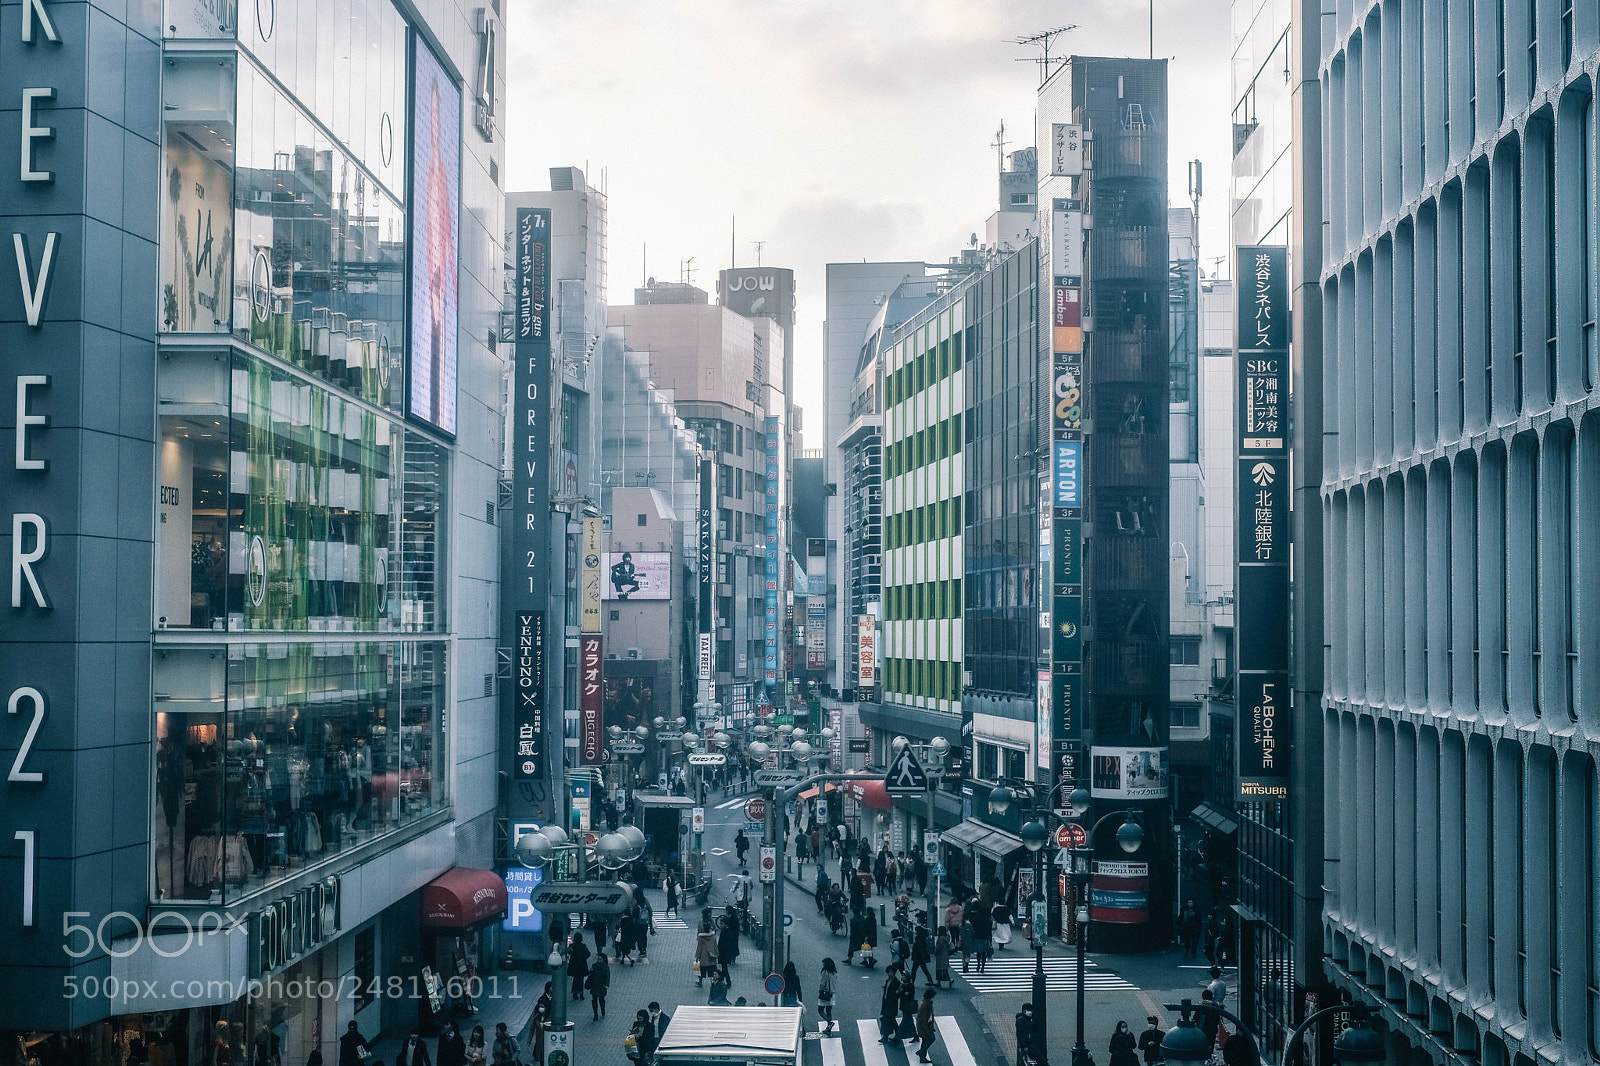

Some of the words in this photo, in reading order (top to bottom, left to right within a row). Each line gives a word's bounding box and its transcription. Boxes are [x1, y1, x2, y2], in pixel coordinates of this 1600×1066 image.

[1068, 129, 1078, 151] 渋谷
[1062, 201, 1073, 209] 7F
[534, 214, 546, 228] 7F
[196, 208, 214, 279] LA
[729, 275, 775, 292] JOW
[1062, 277, 1073, 286] 6F
[1056, 289, 1066, 325] amber
[1254, 253, 1271, 346] 渋谷シネパレス
[1246, 360, 1278, 372] SBC
[1254, 378, 1266, 433] クリニック
[1265, 378, 1278, 433] 湘南美容
[526, 357, 537, 530] FOREVER
[1062, 431, 1073, 440] 4F
[1059, 447, 1076, 502] ARTON
[1062, 508, 1073, 517] 3F
[1255, 489, 1273, 560] 北陸銀行
[701, 509, 710, 584] SAKAZEN
[1064, 528, 1072, 575] PRONTO
[526, 550, 535, 593] 21
[1062, 586, 1073, 595] 2F
[519, 615, 533, 688] VENTUNO
[701, 637, 709, 651] TAX
[585, 639, 600, 696] カラオケ
[860, 635, 873, 679] 美容室
[1062, 664, 1073, 672] 1F
[860, 693, 874, 701] 3F
[1262, 683, 1275, 704] LA
[585, 709, 596, 730] BIG
[585, 730, 596, 760] ECHO
[1062, 742, 1073, 750] B1
[1241, 786, 1287, 795] MITSUBA
[7, 686, 46, 927] 21
[1059, 834, 1085, 842] amer
[535, 891, 623, 905] 渋谷センター街
[512, 898, 535, 927] P
[250, 882, 326, 978] FOREVER
